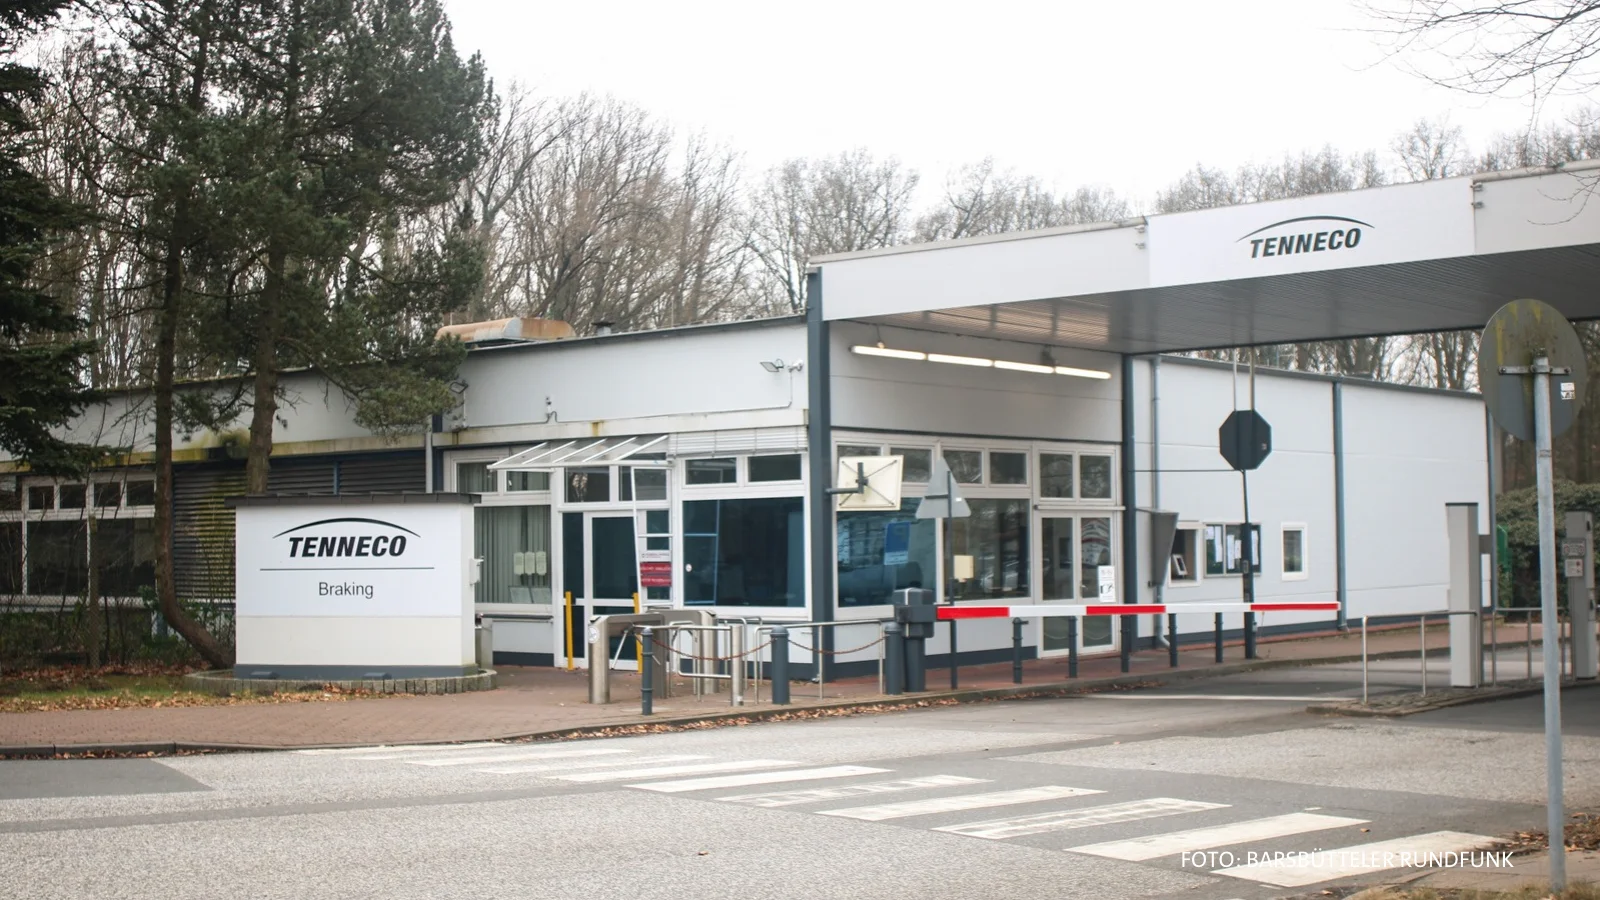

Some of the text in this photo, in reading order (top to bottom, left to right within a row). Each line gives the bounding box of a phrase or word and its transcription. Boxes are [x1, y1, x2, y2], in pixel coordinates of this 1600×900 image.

[1250, 227, 1362, 259] TENNECO
[288, 535, 407, 558] TENNECO
[318, 581, 374, 600] Braking
